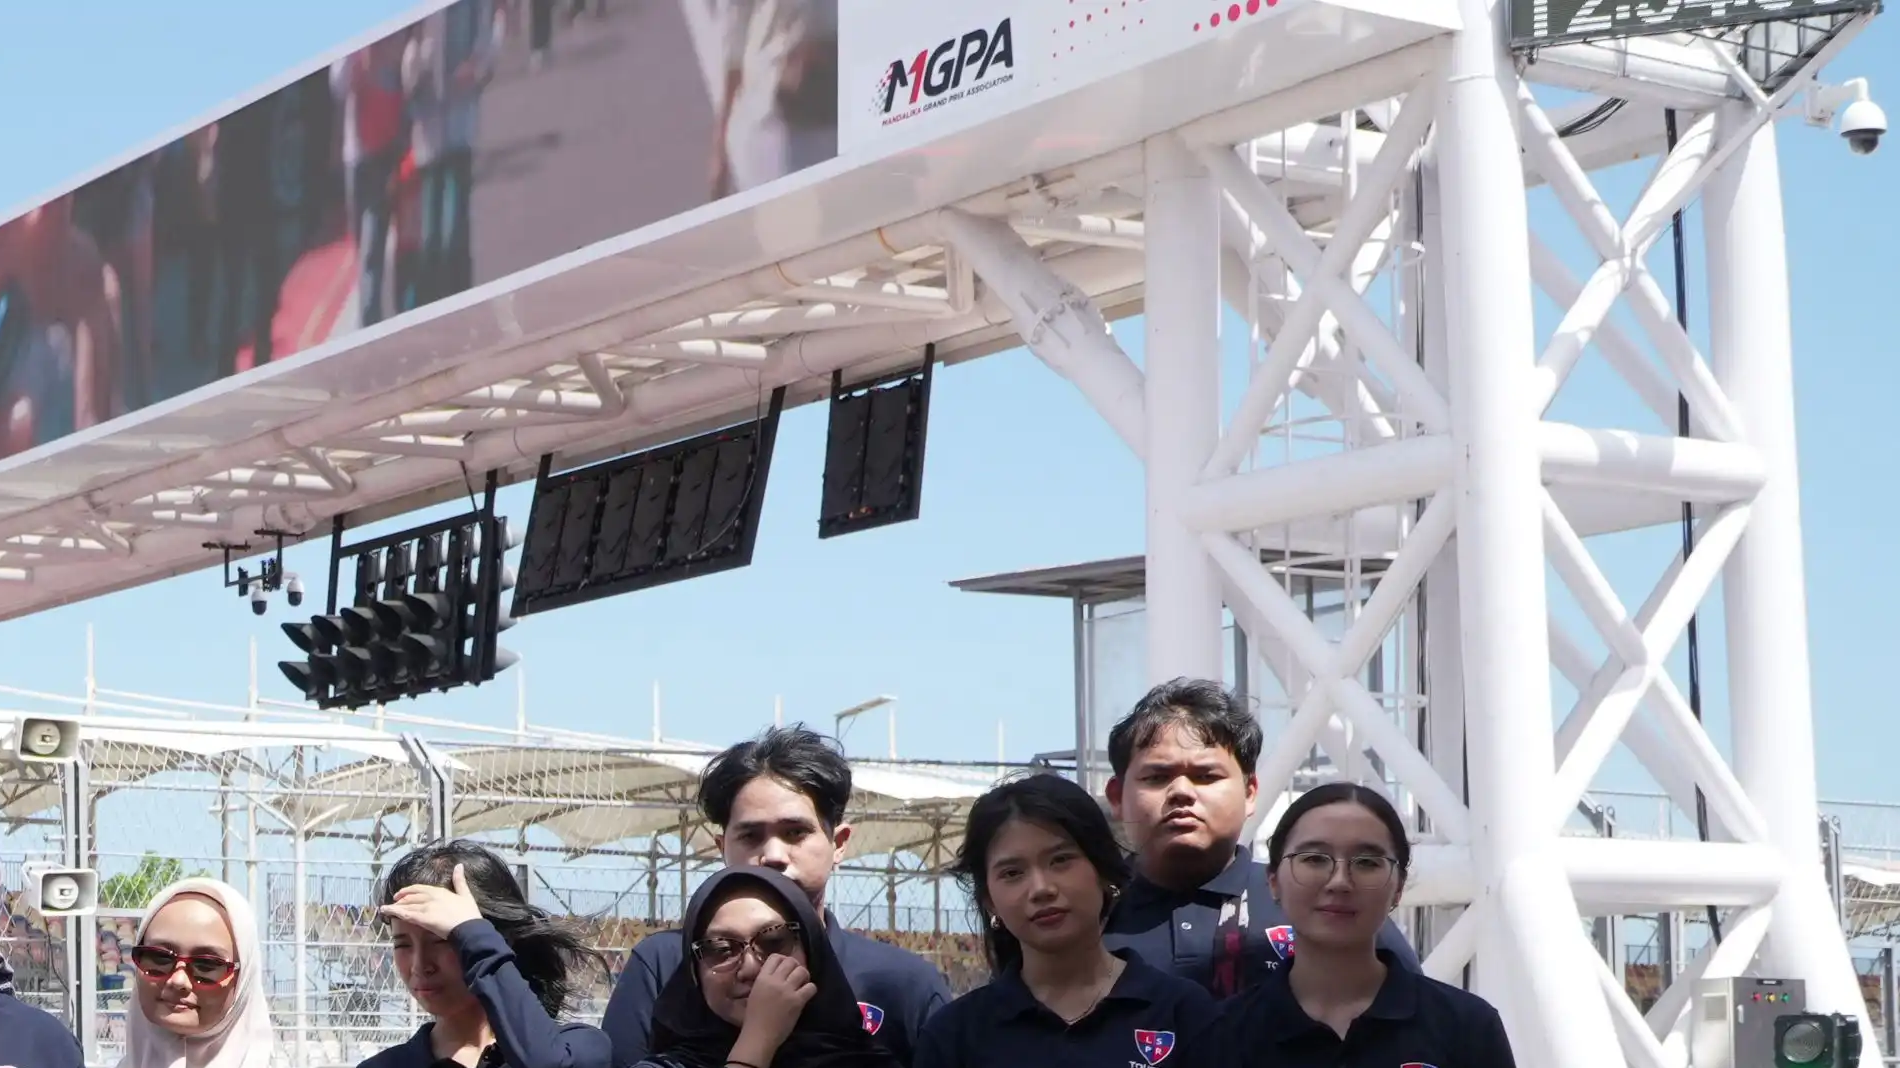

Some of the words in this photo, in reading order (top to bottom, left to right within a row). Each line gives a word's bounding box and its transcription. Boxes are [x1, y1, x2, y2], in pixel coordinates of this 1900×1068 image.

[882, 107, 921, 126] MANDALIKA
[923, 95, 948, 112] GRAND
[948, 91, 965, 104] PRIX
[966, 73, 1014, 97] ASSOCIATION
[883, 17, 1014, 113] MGPA
